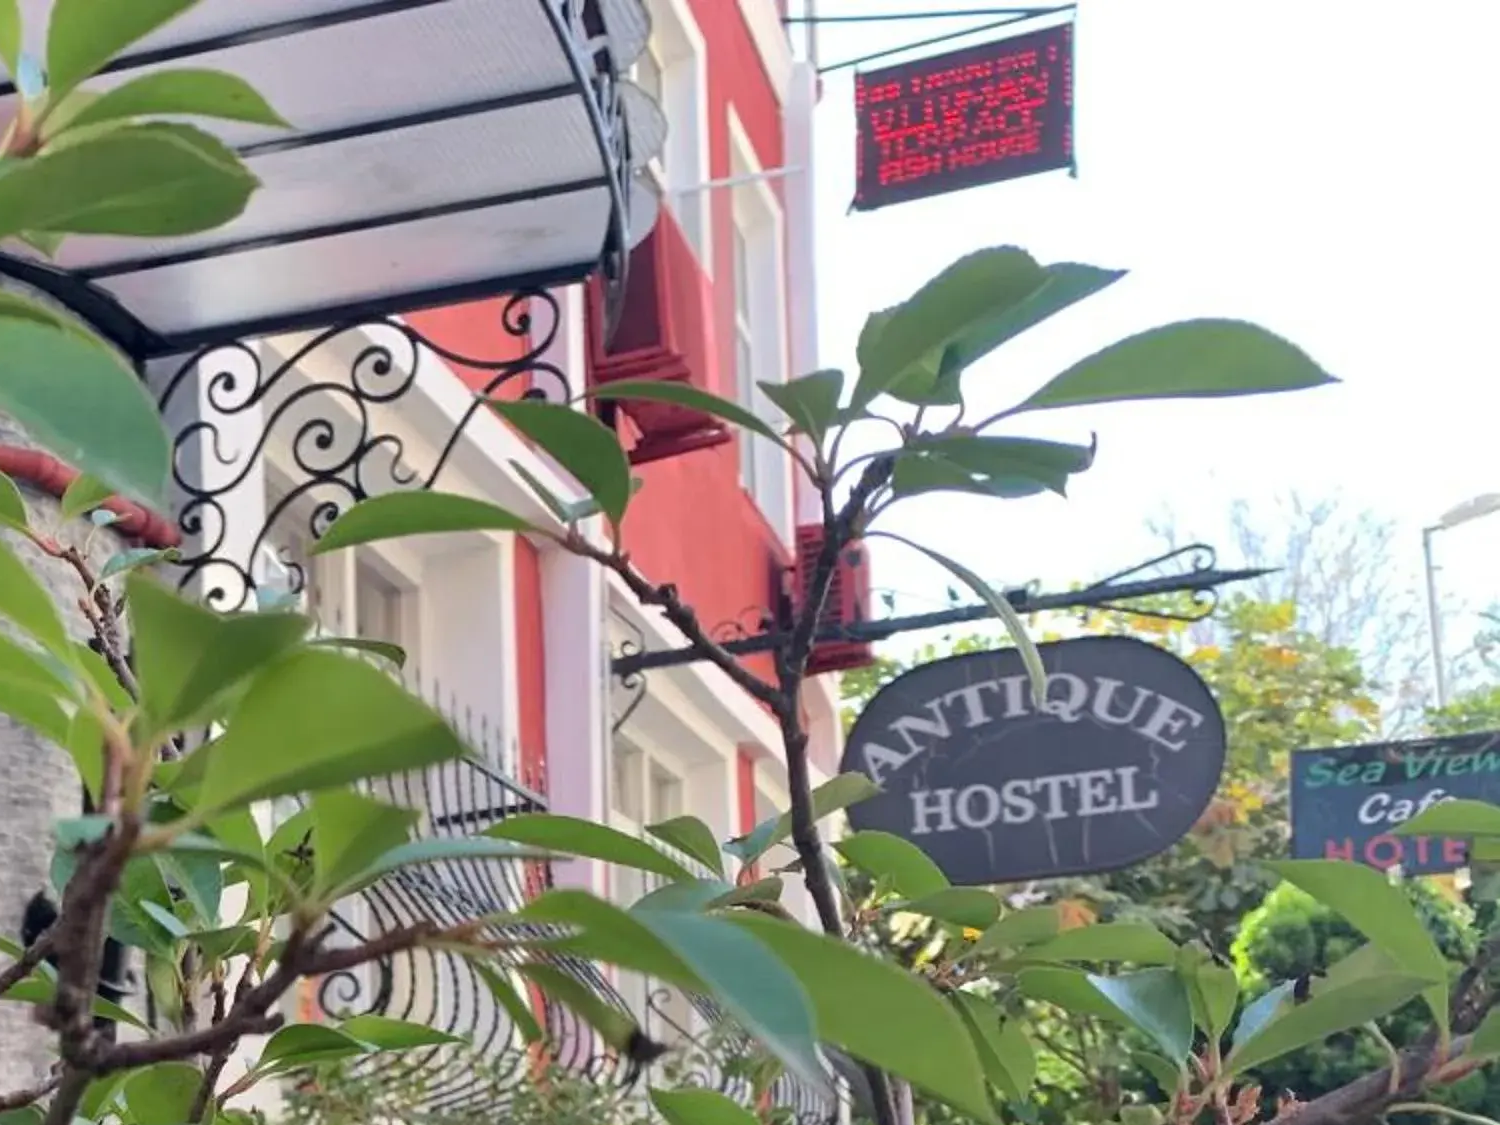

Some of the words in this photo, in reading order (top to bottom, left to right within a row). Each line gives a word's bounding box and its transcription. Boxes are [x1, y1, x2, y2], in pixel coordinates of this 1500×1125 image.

[858, 672, 1204, 784] ANTIQUE
[1305, 757, 1386, 788] Sea
[1404, 746, 1500, 779] View
[910, 765, 1158, 834] HOSTEL
[1358, 788, 1457, 824] Caf
[1325, 833, 1467, 870] HOTE
